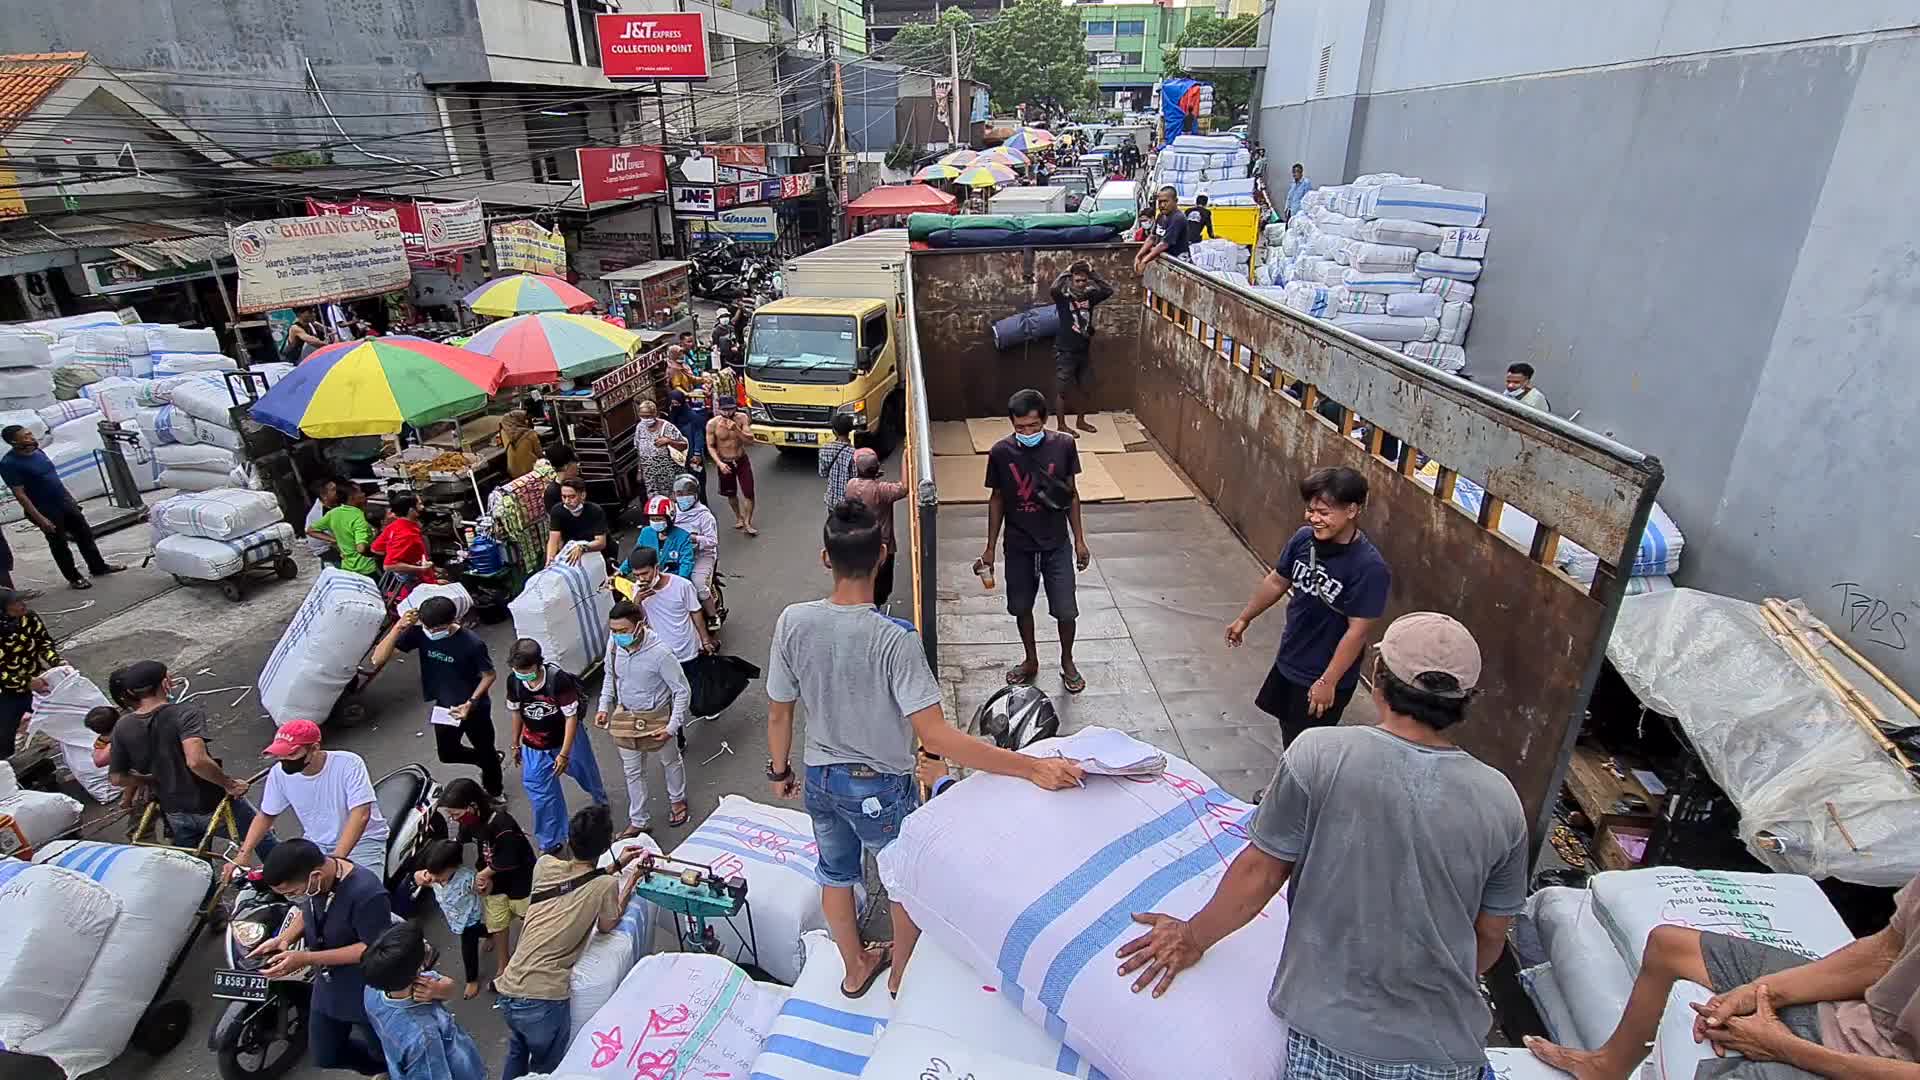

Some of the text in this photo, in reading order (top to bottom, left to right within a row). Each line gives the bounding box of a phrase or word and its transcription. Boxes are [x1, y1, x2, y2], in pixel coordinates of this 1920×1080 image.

[620, 21, 682, 39] J&T EXPRESS
[611, 44, 693, 54] COLLECTION POINT
[608, 152, 631, 173] J&T
[678, 189, 712, 204] JNE
[722, 213, 767, 224] WAHANA
[280, 220, 349, 239] GEMILANG
[350, 215, 398, 232] CARGO
[217, 974, 266, 989] B 6583 PZL
